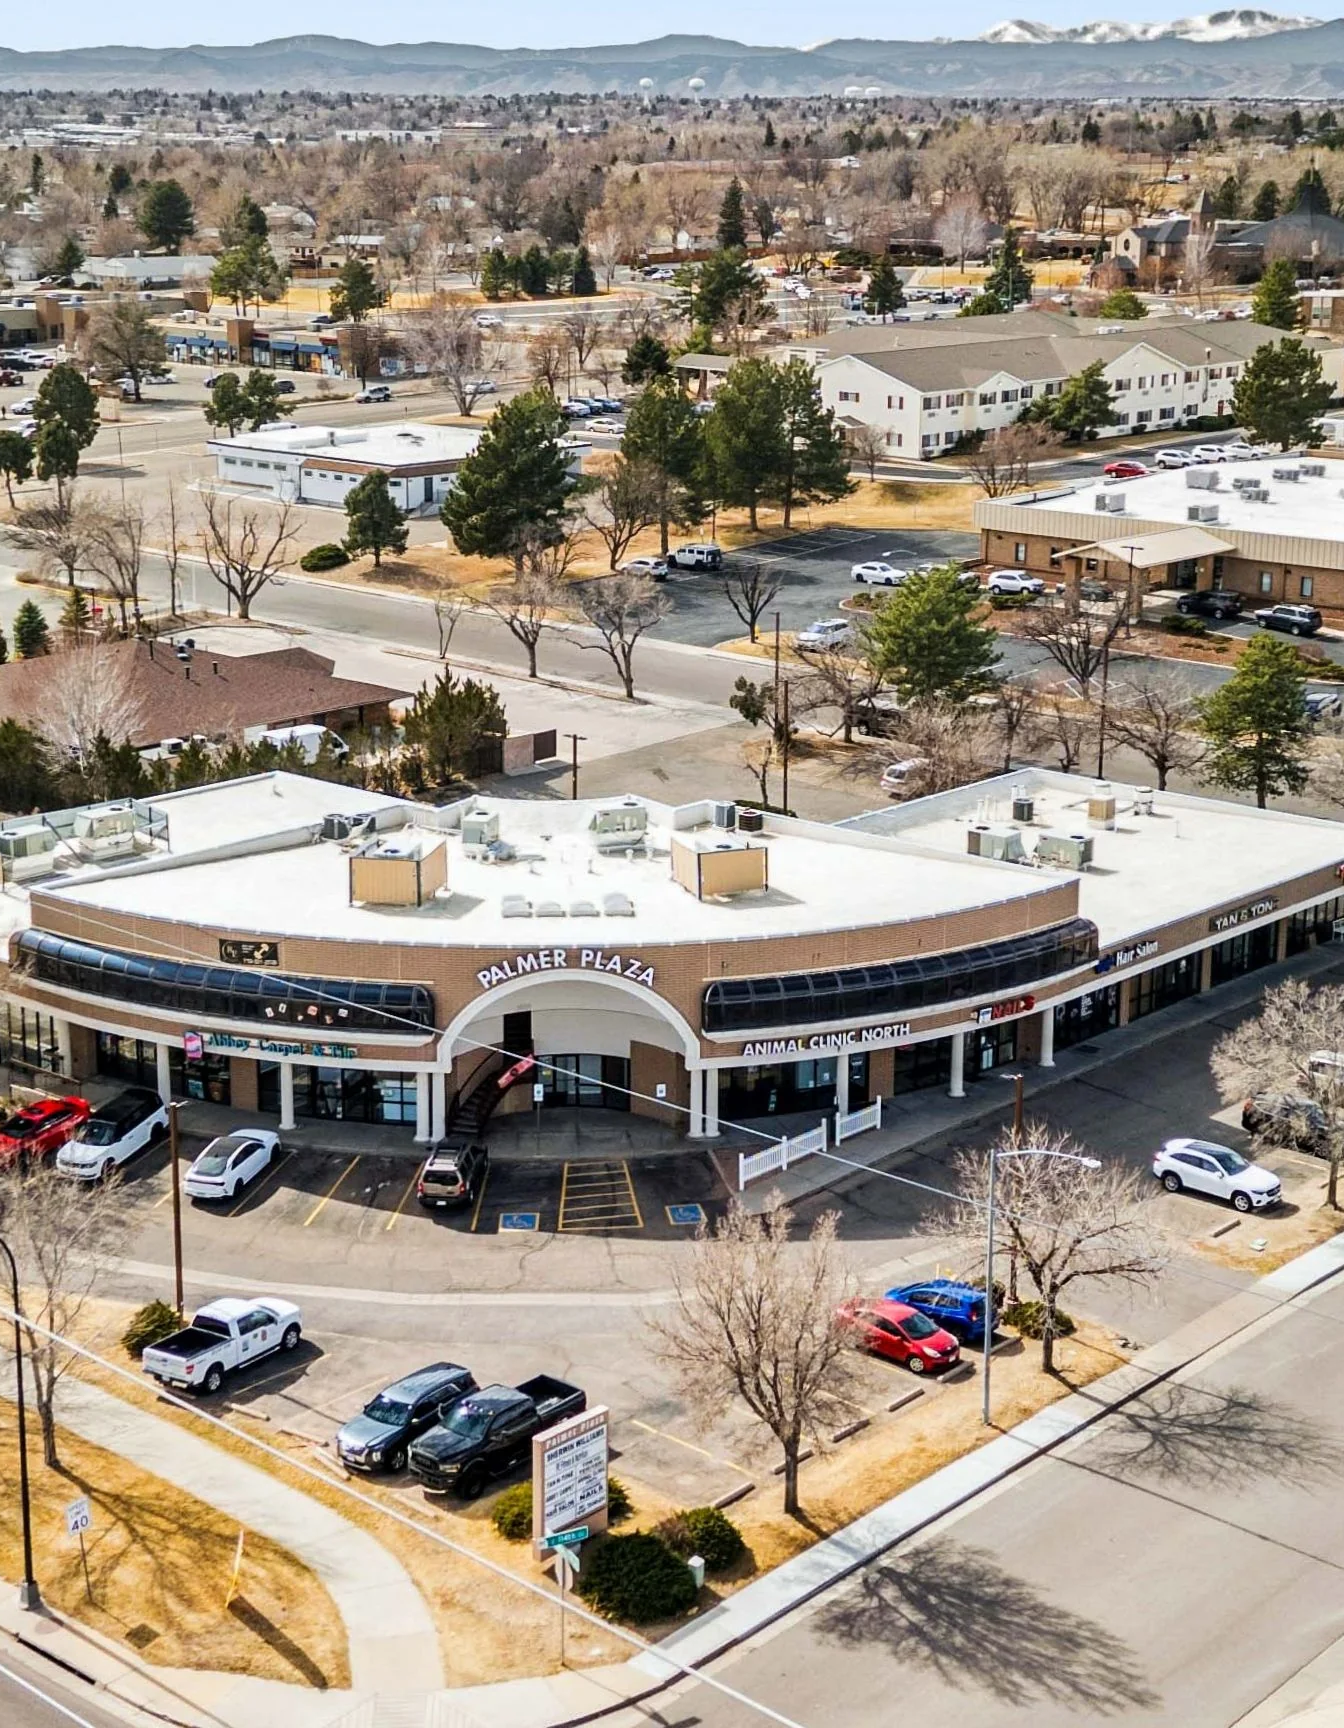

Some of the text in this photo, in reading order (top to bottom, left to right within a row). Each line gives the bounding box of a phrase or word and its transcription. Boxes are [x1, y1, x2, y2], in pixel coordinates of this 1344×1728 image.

[1215, 911, 1238, 931] TAN
[1116, 949, 1135, 967] Hair
[1136, 941, 1159, 959] Salon
[477, 950, 655, 989] PALMER PLAZA
[991, 995, 1035, 1019] NAILS
[743, 1023, 910, 1057] ANIMAL CLINIC NORTH
[71, 1515, 88, 1531] 40
